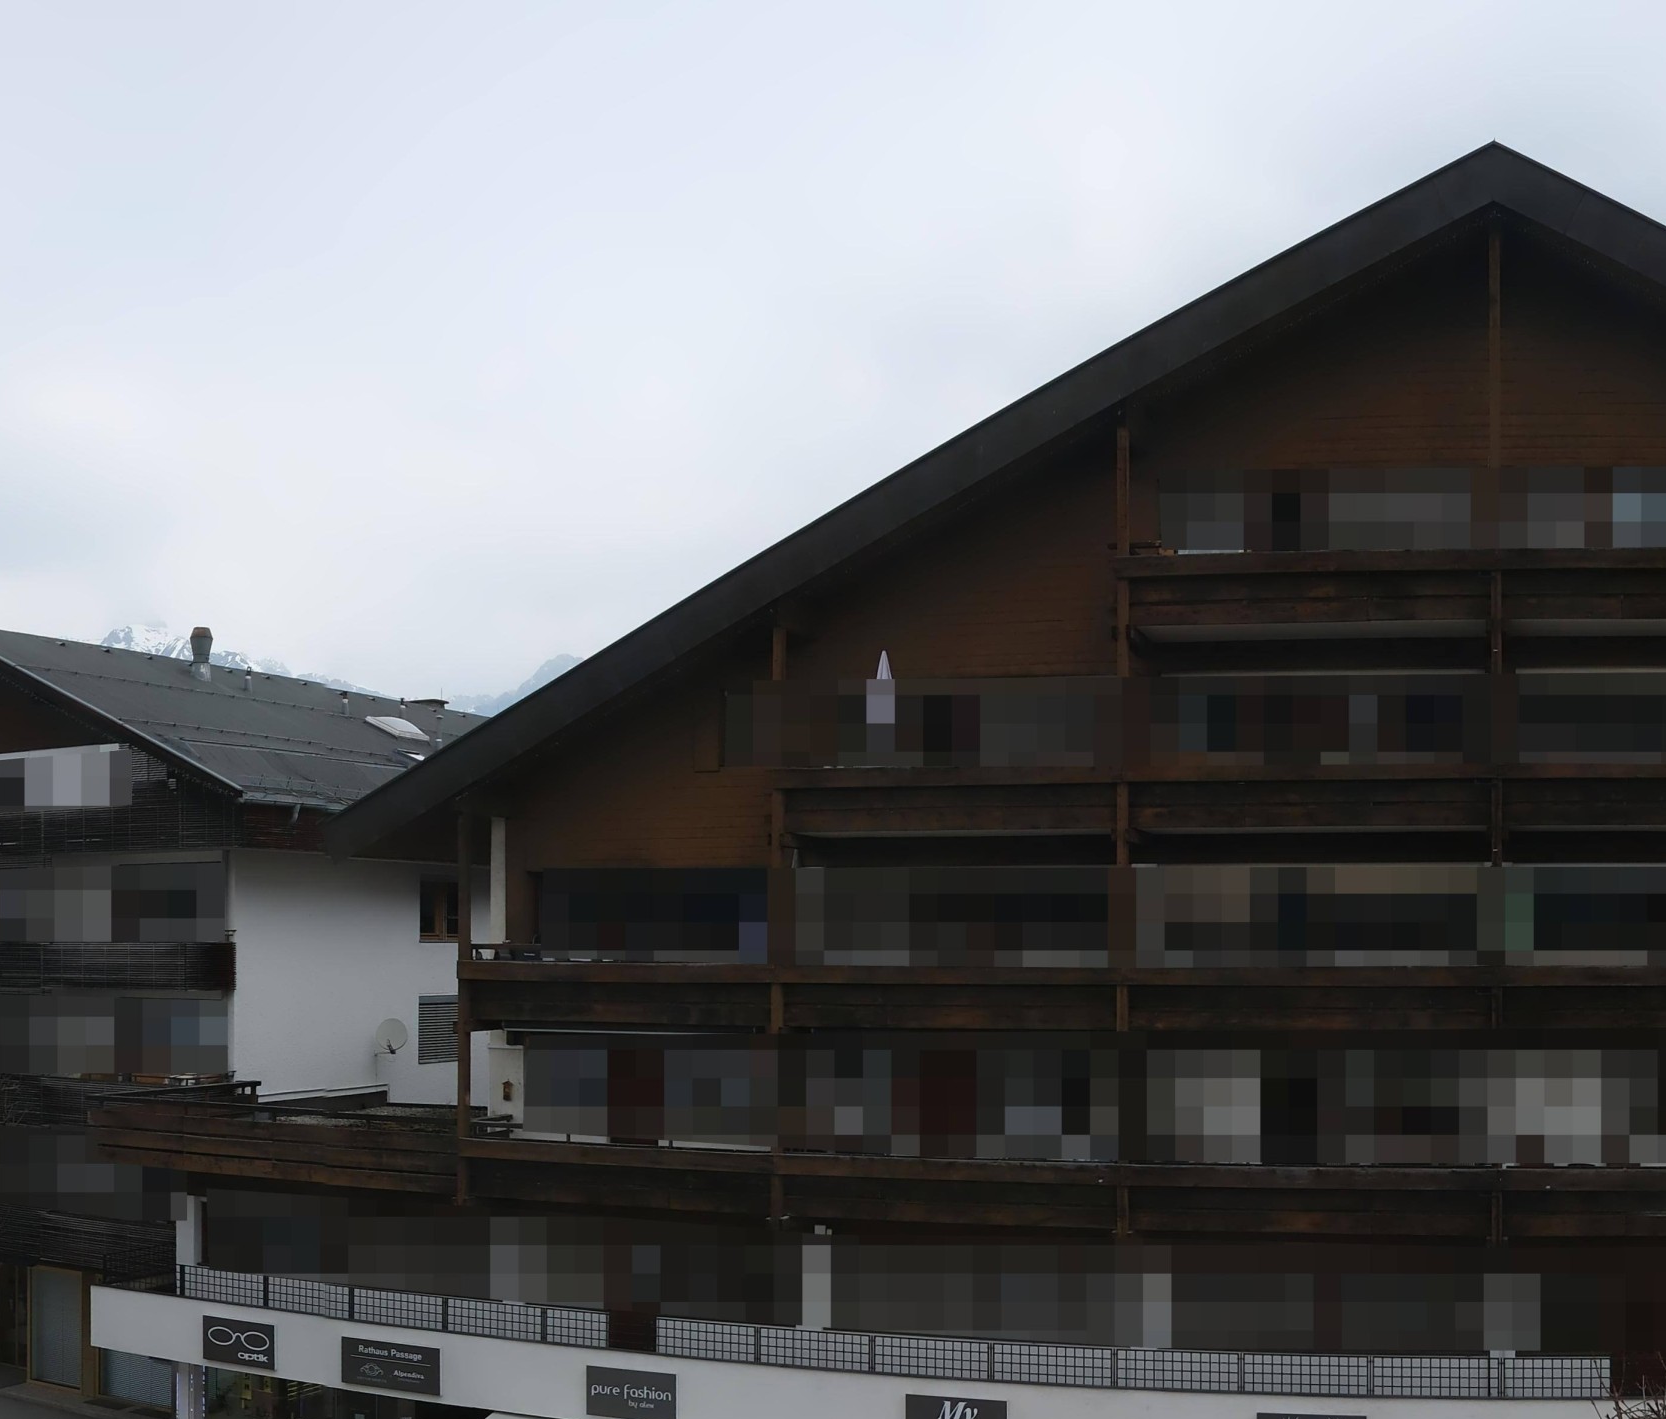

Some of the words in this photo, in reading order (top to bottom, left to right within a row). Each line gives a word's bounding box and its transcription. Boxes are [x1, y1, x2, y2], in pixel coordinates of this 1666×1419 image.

[238, 1351, 269, 1363] optik
[359, 1345, 389, 1357] Rathaus
[391, 1348, 423, 1362] Passage
[591, 1384, 621, 1396] pure
[624, 1384, 672, 1401] fashion
